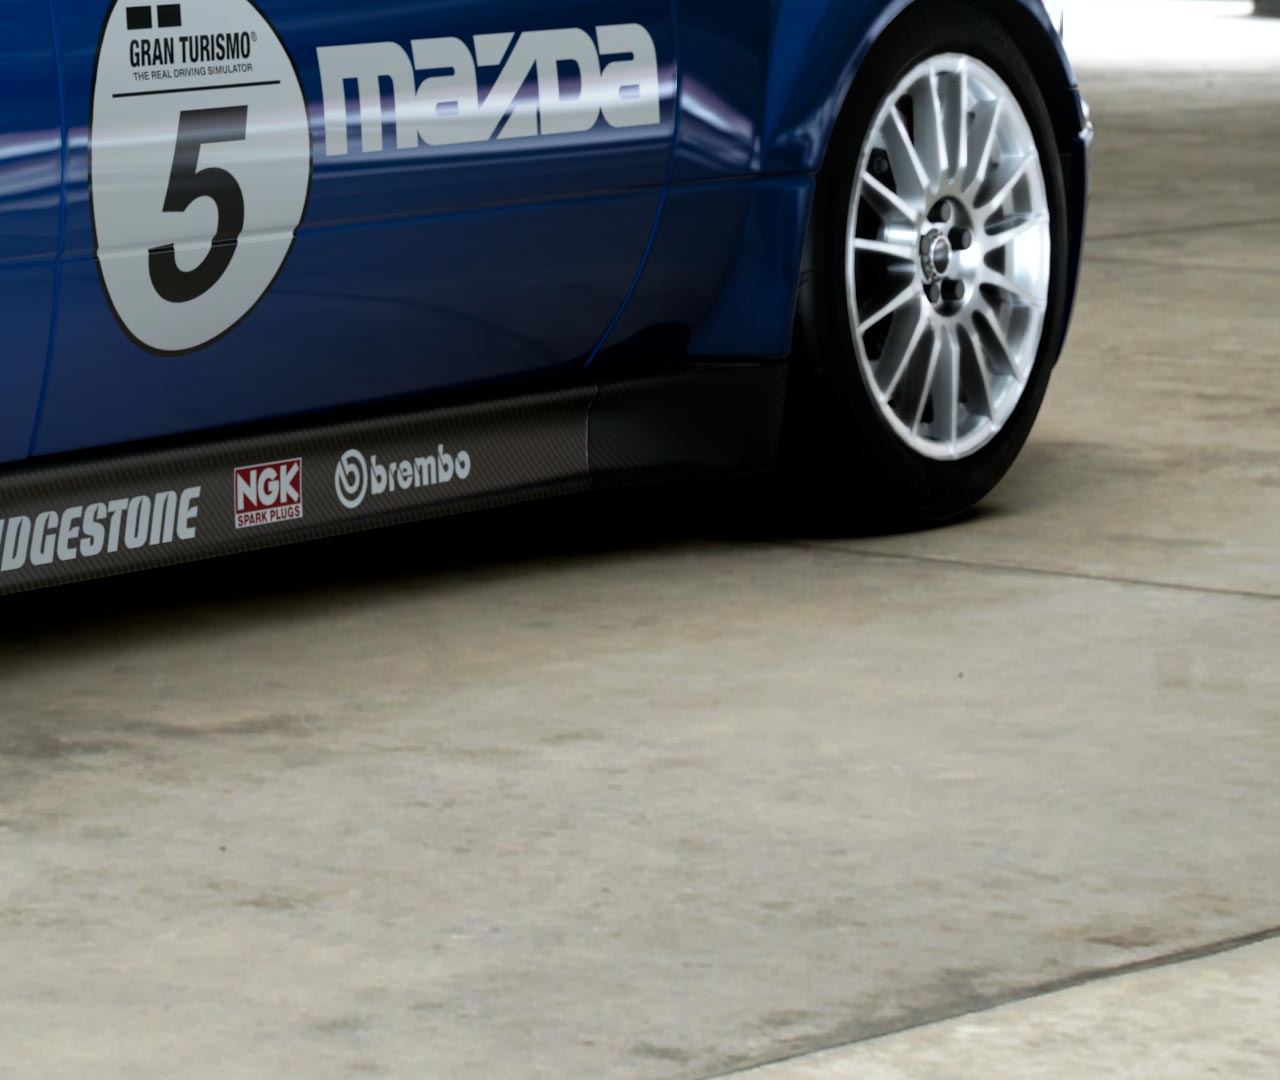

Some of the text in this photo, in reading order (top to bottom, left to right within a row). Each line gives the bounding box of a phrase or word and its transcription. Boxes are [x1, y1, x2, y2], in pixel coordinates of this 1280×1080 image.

[129, 36, 175, 67] GRAN
[133, 63, 253, 81] THE REAL DRIVING SIMULATOR
[148, 105, 248, 303] 5
[237, 462, 300, 510] NGK
[371, 444, 471, 495] brembo
[237, 506, 301, 527] SPARK PLUGS
